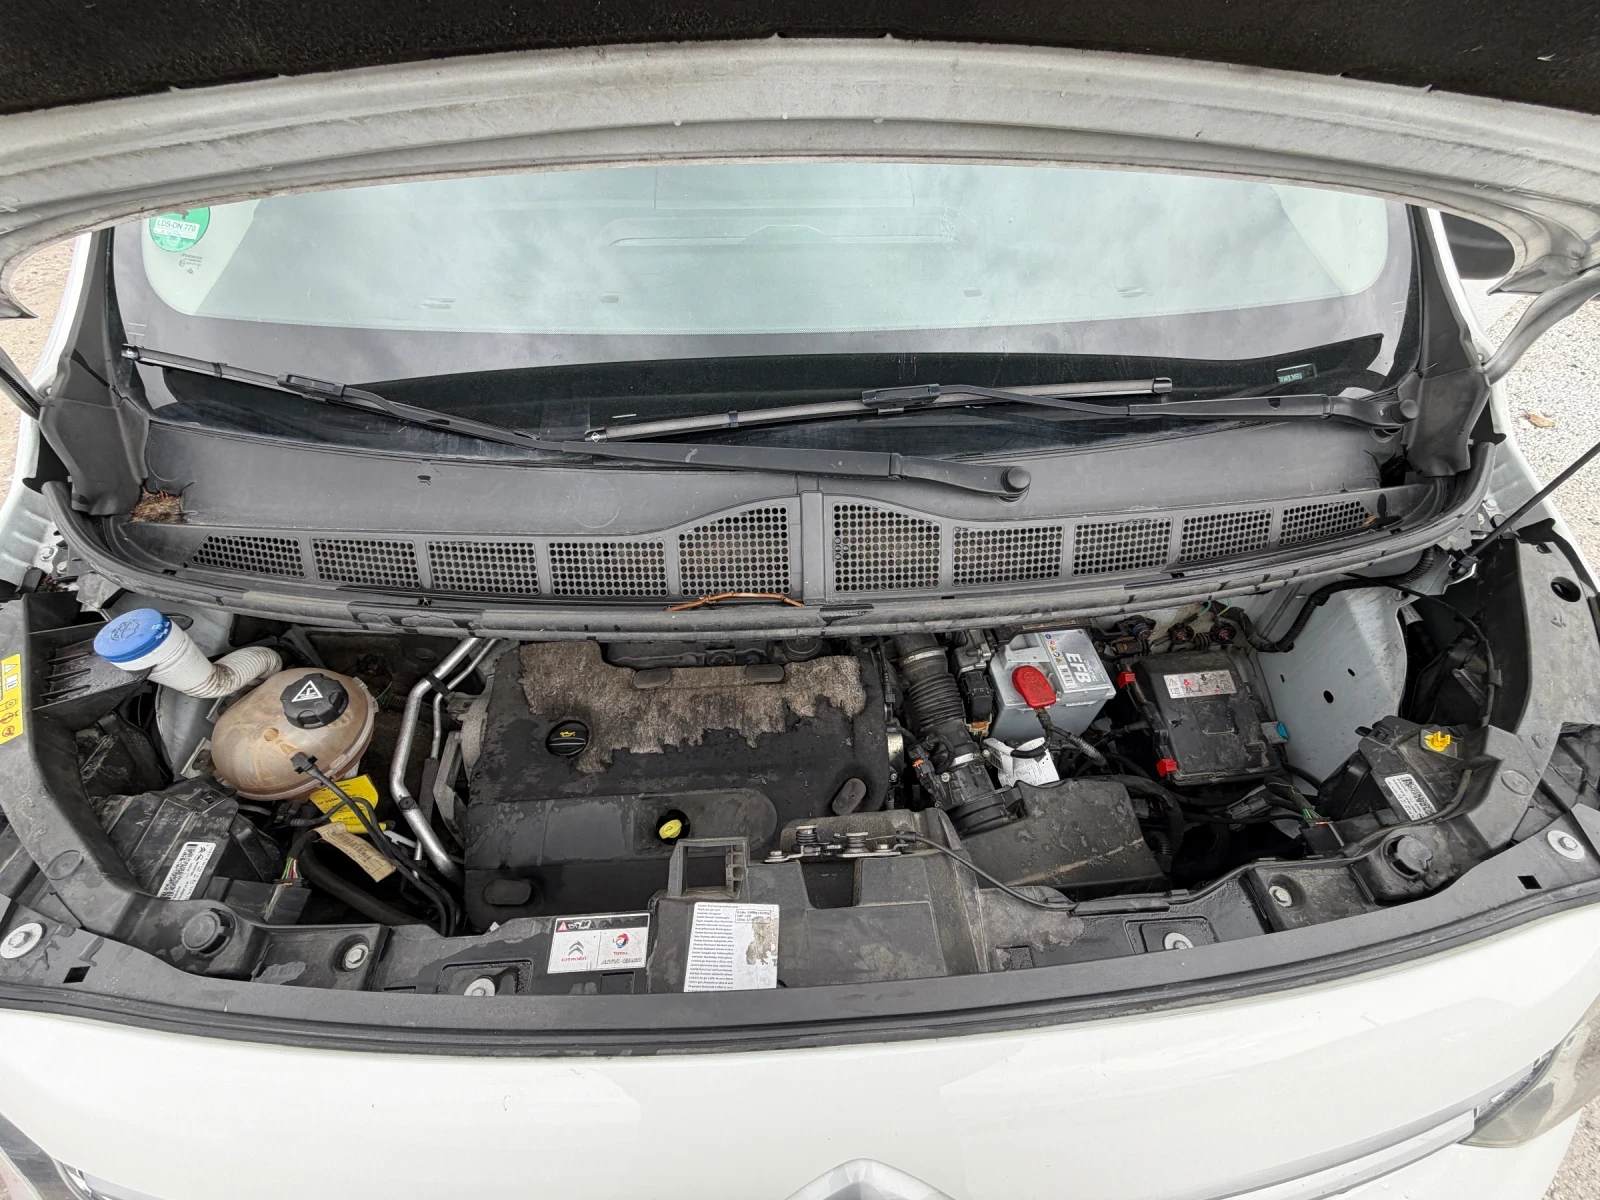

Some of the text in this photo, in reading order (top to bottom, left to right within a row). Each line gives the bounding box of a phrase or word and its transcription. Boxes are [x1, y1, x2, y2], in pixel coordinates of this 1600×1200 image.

[157, 219, 183, 229] LDS-DN
[184, 224, 196, 232] 770
[1065, 653, 1091, 682] EFB
